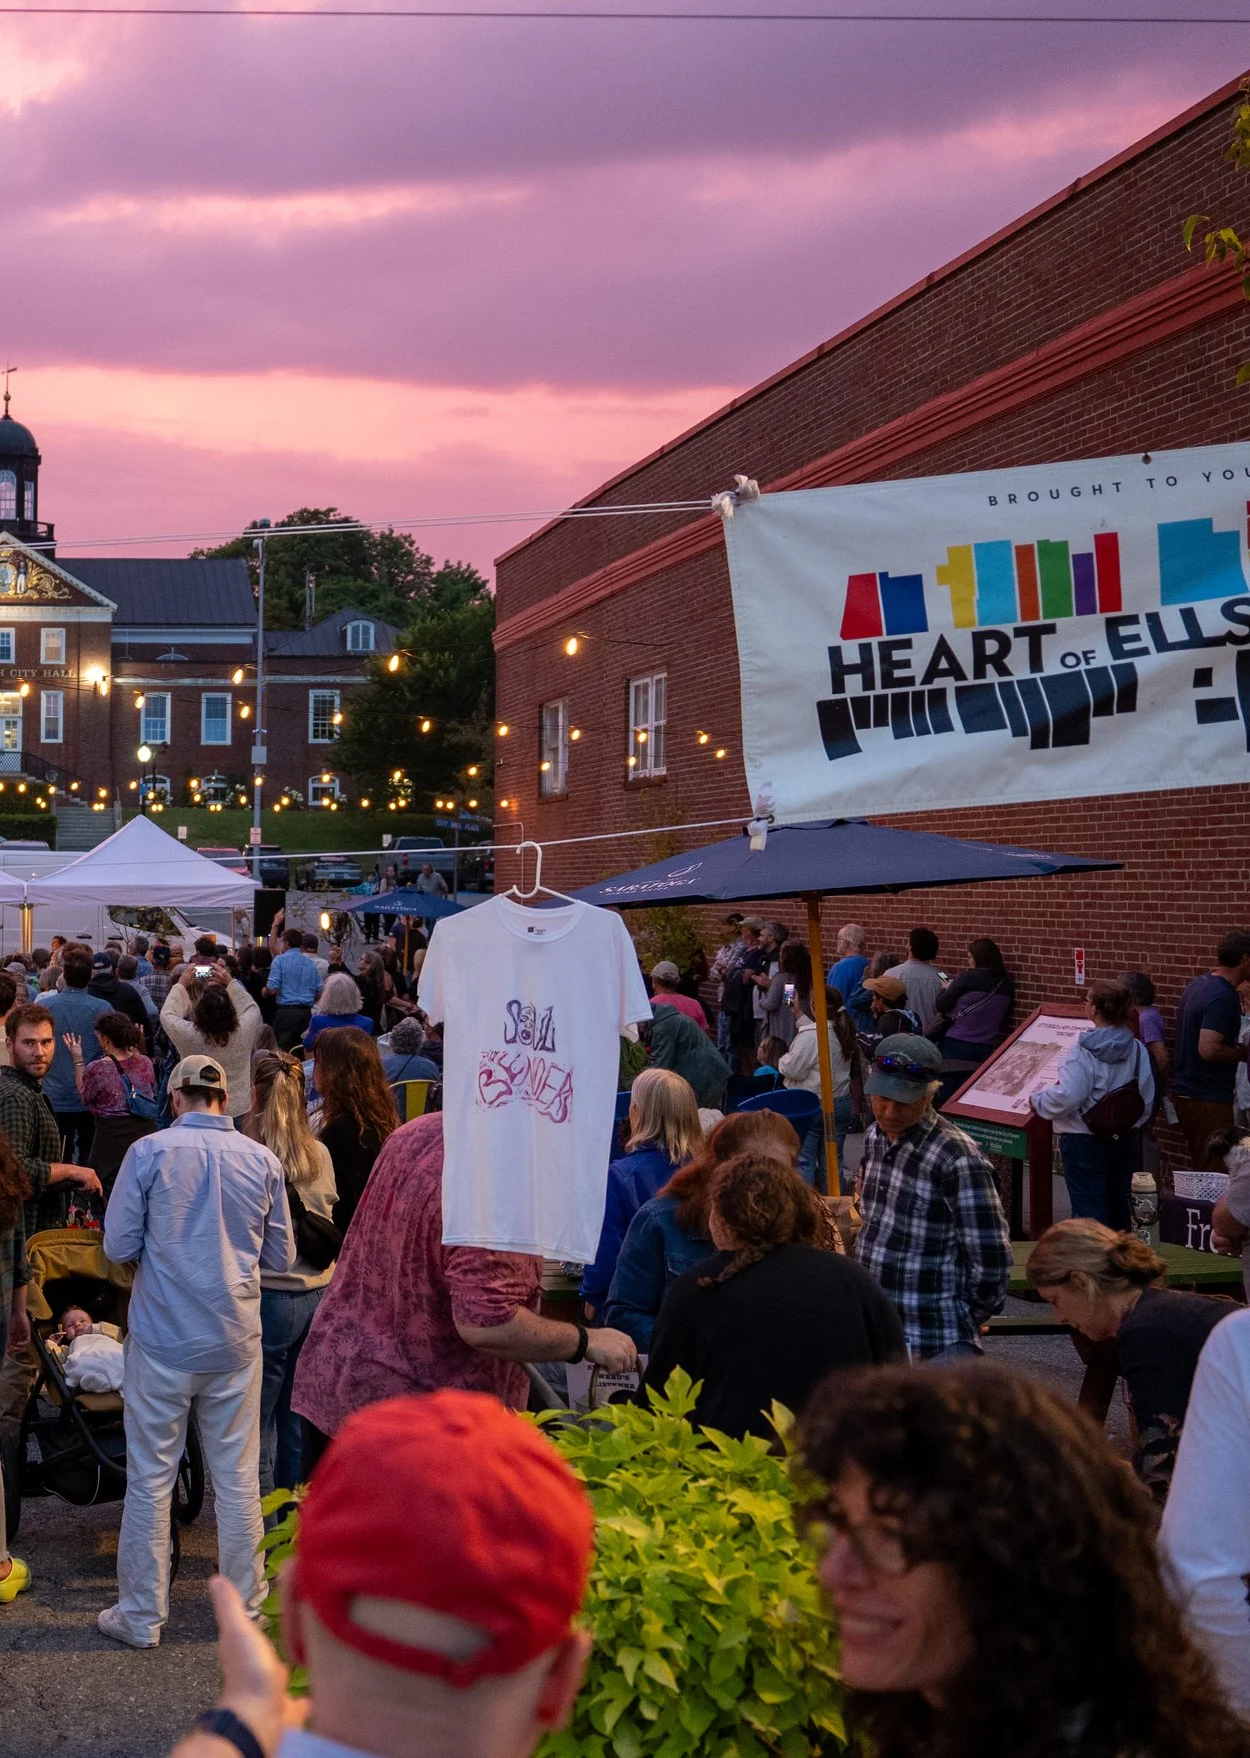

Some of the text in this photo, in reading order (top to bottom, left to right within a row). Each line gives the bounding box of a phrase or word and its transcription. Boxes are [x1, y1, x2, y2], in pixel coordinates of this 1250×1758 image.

[988, 482, 1121, 506] BROUGHT
[1146, 475, 1178, 489] TO
[10, 668, 38, 678] CITY
[43, 669, 76, 678] HALL
[827, 622, 1057, 695] HEART
[1059, 649, 1098, 670] OF
